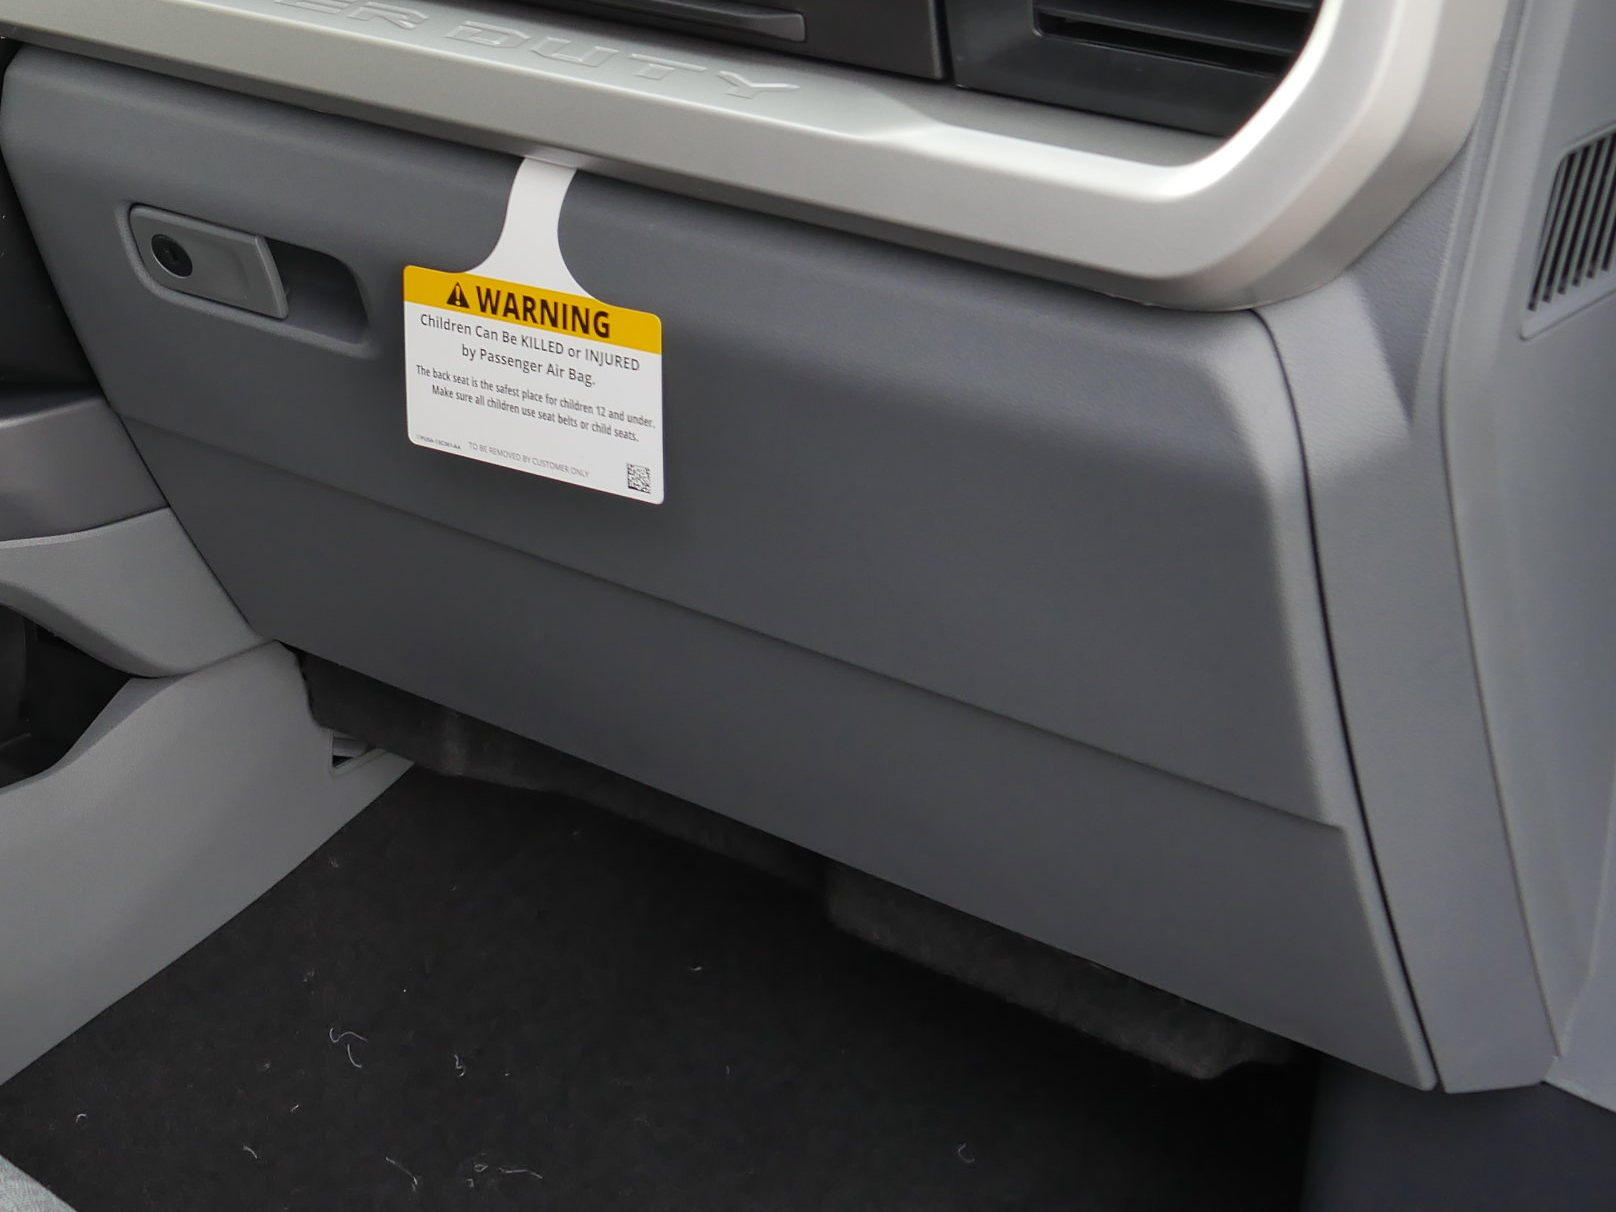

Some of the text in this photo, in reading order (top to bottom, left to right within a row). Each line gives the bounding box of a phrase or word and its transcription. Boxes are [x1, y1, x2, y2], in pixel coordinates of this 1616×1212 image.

[444, 20, 801, 100] DUTY
[475, 285, 611, 338] WARNING
[420, 313, 640, 371] Children Can Be KILLED or INJURED
[461, 344, 596, 388] by Passenger Air Bag.
[416, 364, 656, 429] The back seat is the safest place for children 12 and under.
[432, 385, 639, 442] Make sure all children use seat belts or child seats.
[468, 440, 478, 450] TO
[479, 443, 488, 453] BE
[489, 446, 521, 461] REMOVED
[522, 454, 531, 464] BY
[532, 457, 570, 474] CUSTOMER
[571, 466, 589, 478] ONLY
